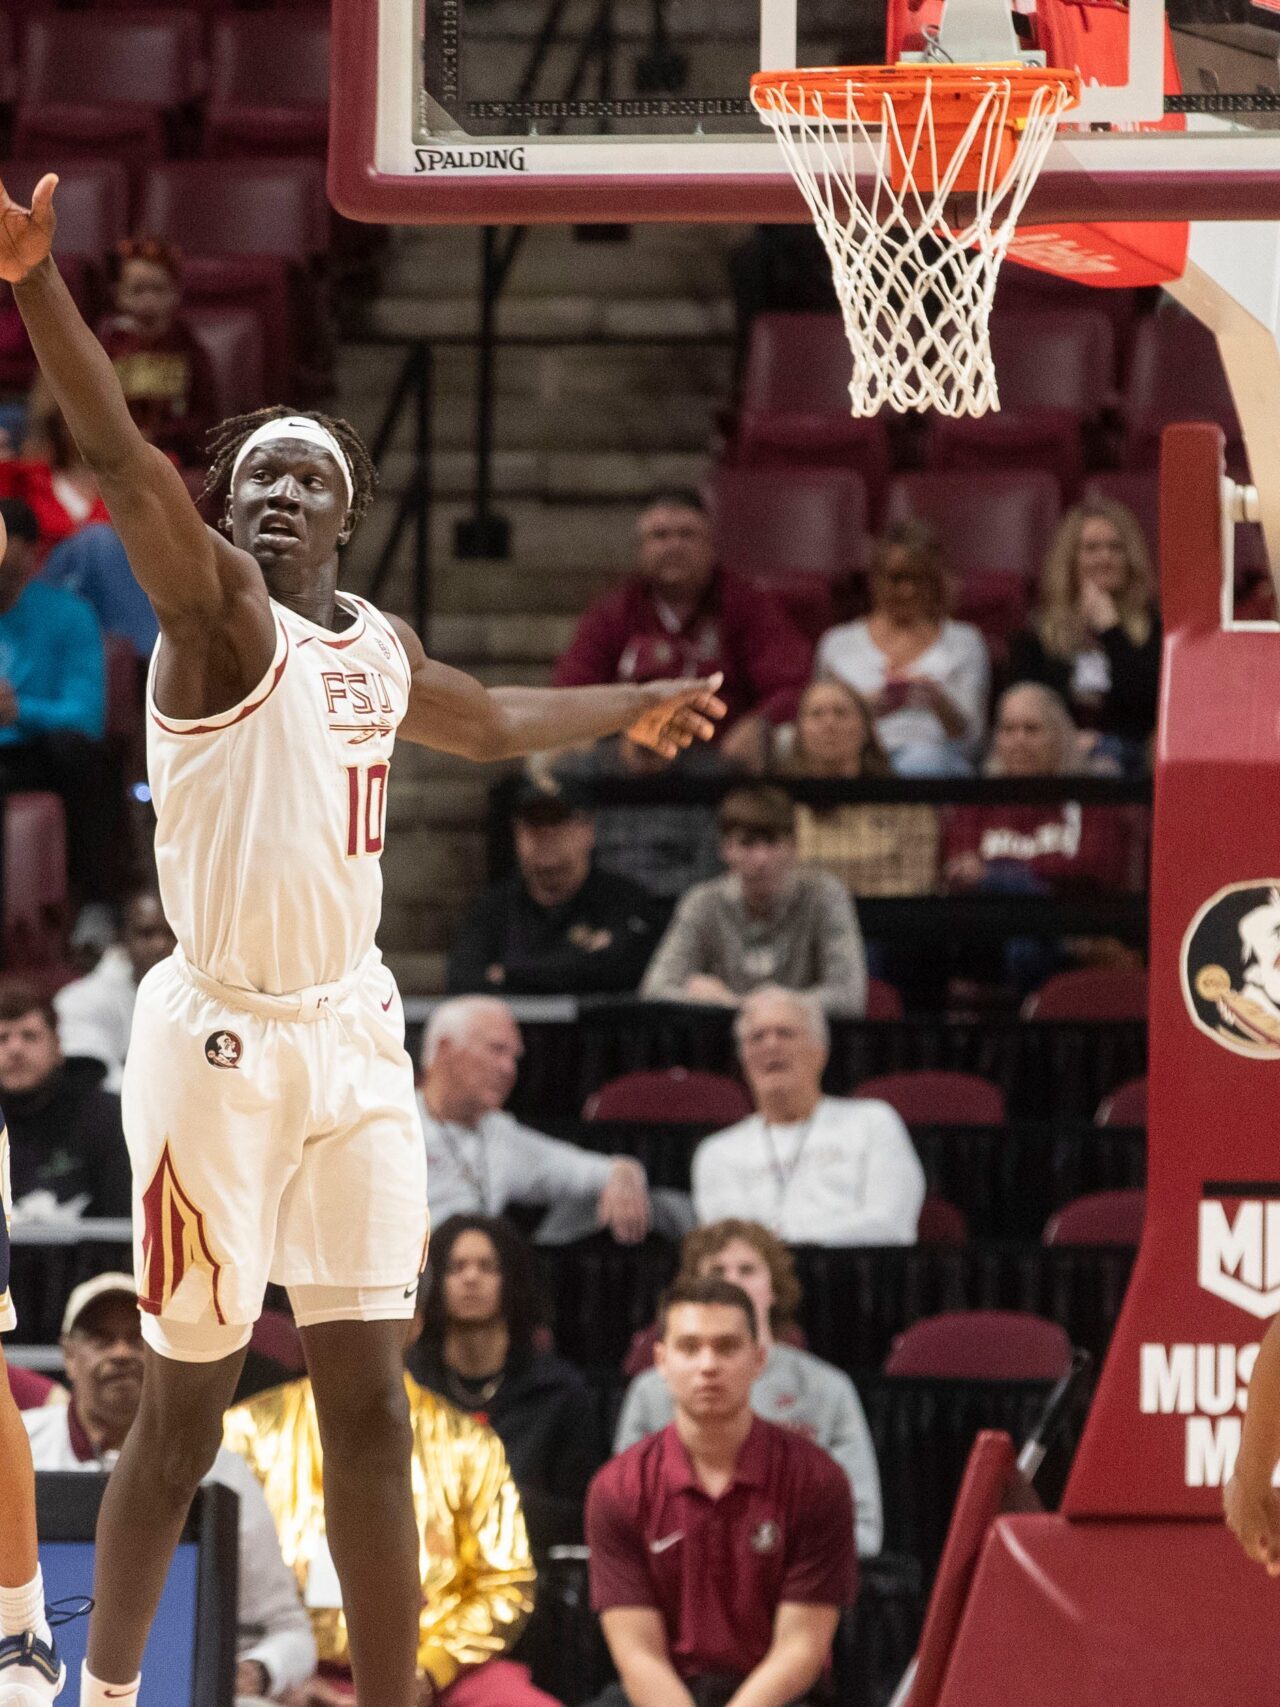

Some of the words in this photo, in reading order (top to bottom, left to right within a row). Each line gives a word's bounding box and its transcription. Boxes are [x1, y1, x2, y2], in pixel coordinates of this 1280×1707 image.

[415, 147, 525, 173] SPALDING
[321, 671, 395, 714] FSU
[343, 760, 391, 858] 10
